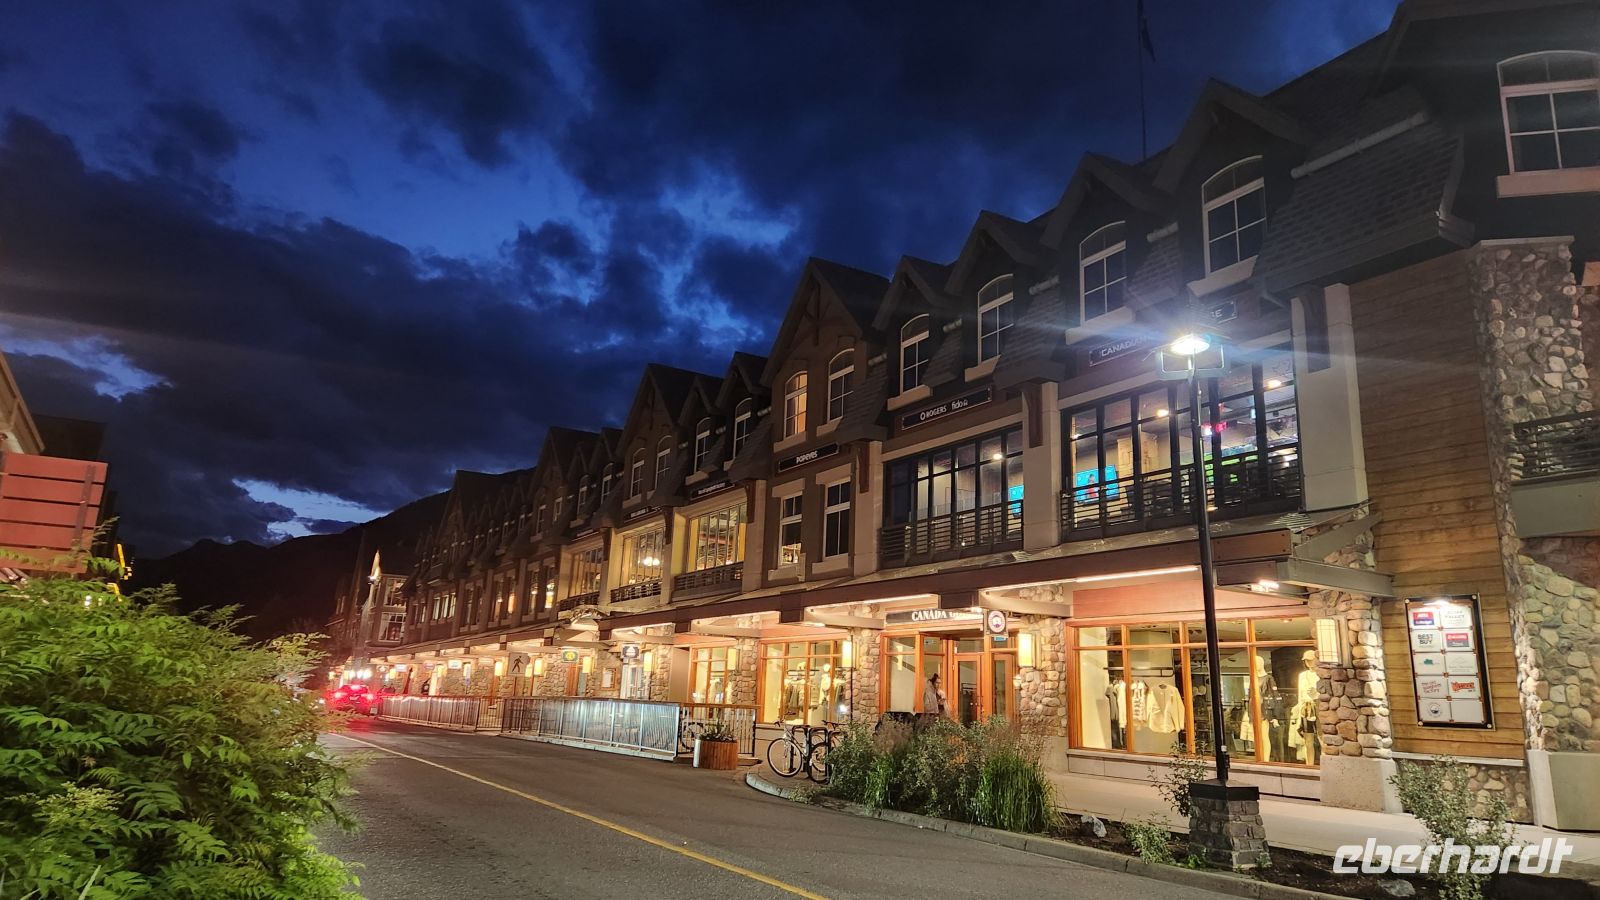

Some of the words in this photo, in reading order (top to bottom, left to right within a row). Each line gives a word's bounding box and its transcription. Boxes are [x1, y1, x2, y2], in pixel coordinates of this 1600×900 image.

[926, 405, 948, 418] ROGERS
[796, 450, 818, 463] POPEYES
[911, 609, 947, 621] CANADA
